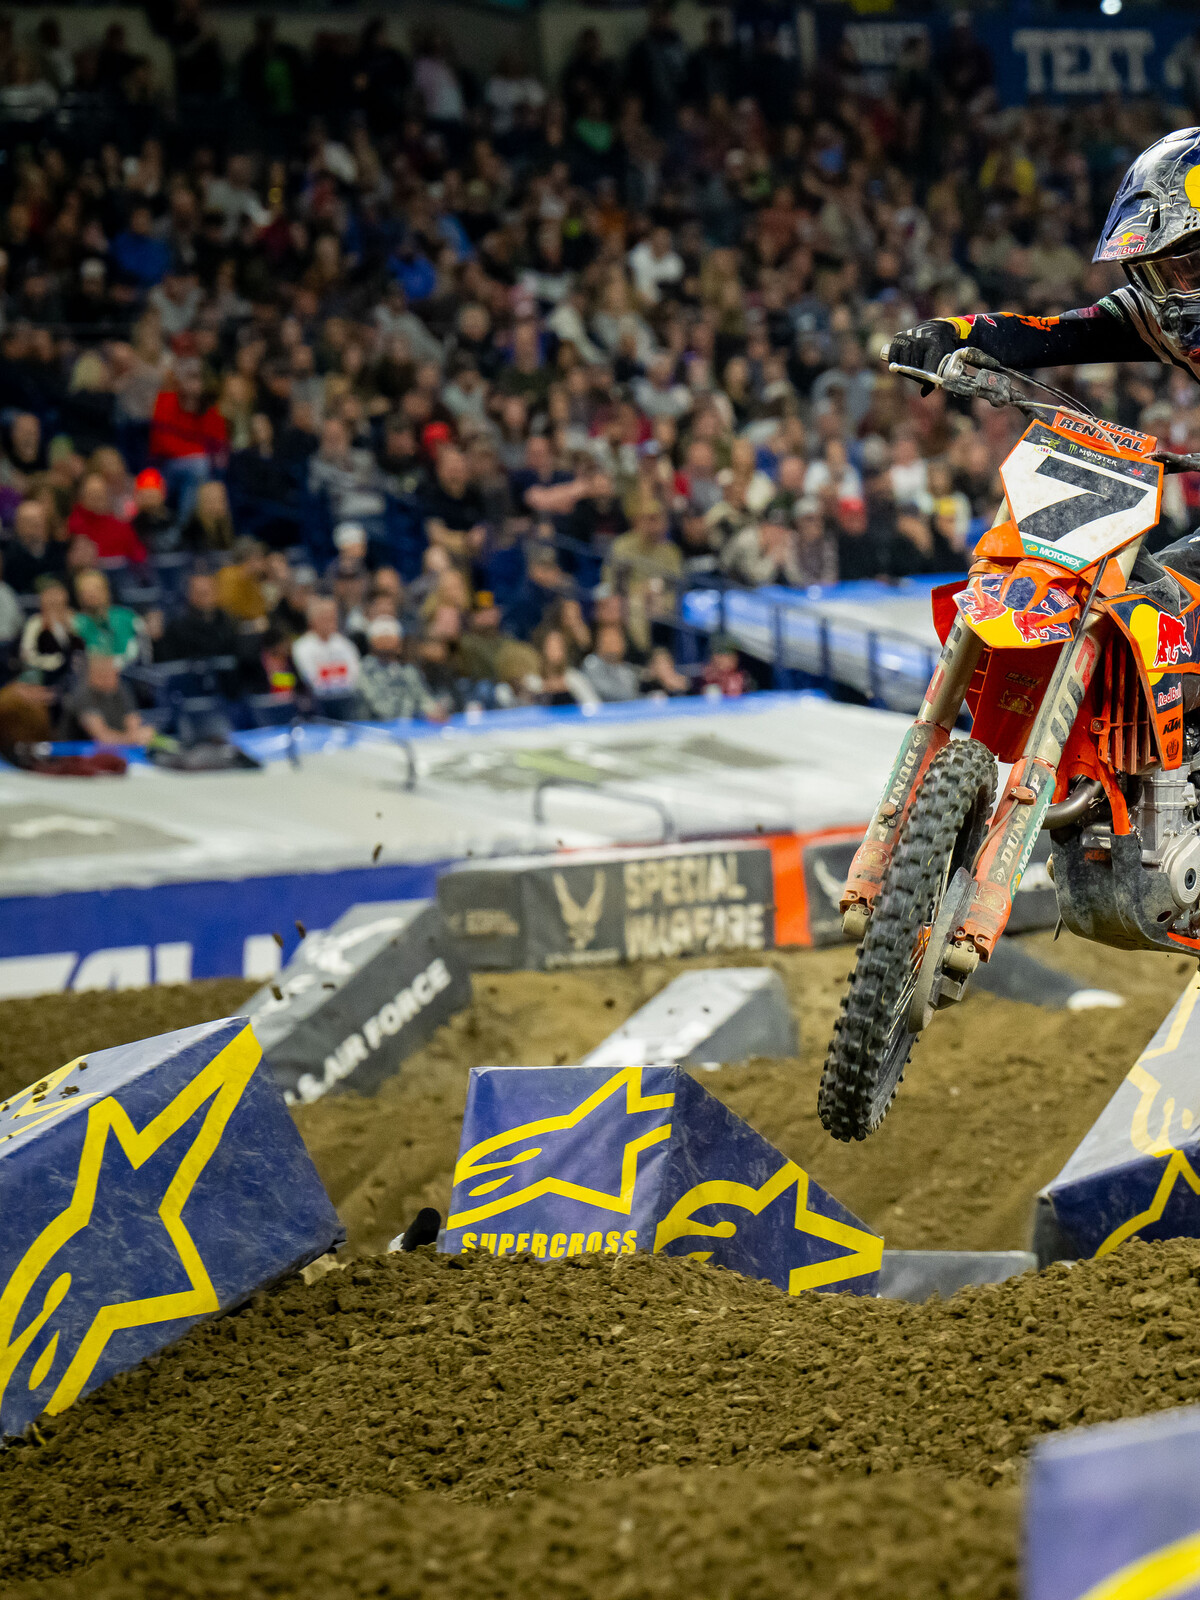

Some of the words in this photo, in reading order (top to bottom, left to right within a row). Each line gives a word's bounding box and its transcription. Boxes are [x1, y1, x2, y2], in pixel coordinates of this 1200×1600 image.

[1011, 28, 1156, 93] TEXT
[1058, 417, 1143, 452] RENTHAL
[1017, 455, 1149, 542] 7
[1038, 546, 1084, 569] MOTOREX
[1163, 717, 1181, 735] KTM
[878, 748, 919, 842] DUNLP
[1001, 773, 1041, 867] DUNLP
[623, 852, 747, 909] SPECIAL
[324, 1033, 369, 1088] AIR
[362, 957, 452, 1050] FORCE
[461, 1229, 638, 1259] SUPERCROSS
